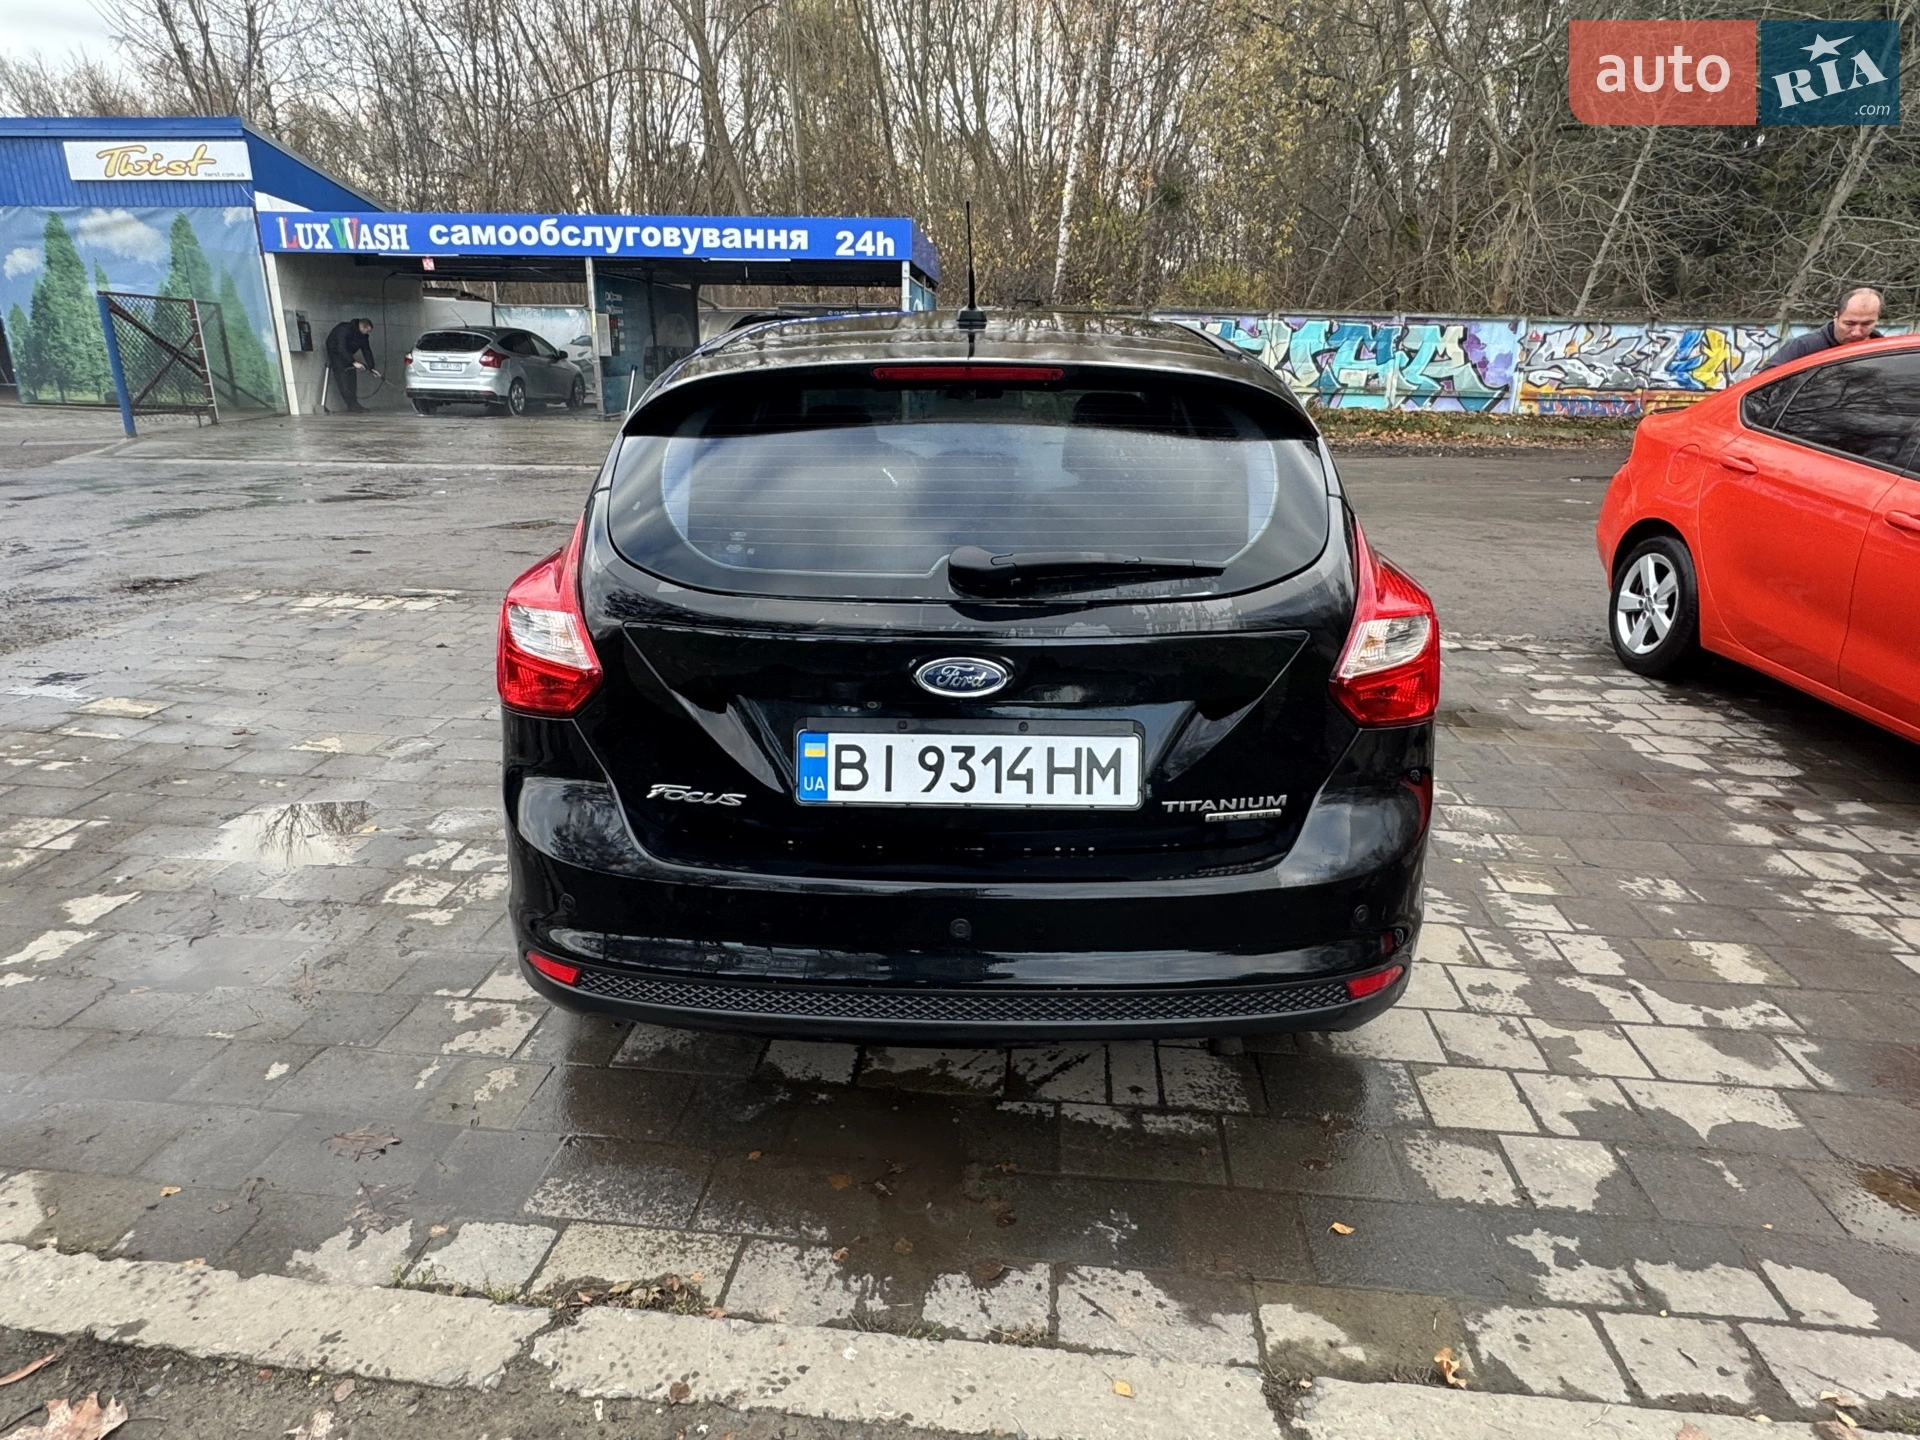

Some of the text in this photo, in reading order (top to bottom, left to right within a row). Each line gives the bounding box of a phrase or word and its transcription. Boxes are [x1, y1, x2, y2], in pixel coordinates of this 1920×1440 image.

[96, 144, 217, 178] Twist
[429, 218, 808, 255] самообслуговування
[835, 230, 895, 256] 24h
[936, 665, 987, 688] Ford
[804, 777, 825, 791] UA
[1161, 794, 1287, 813] TITANIUM
